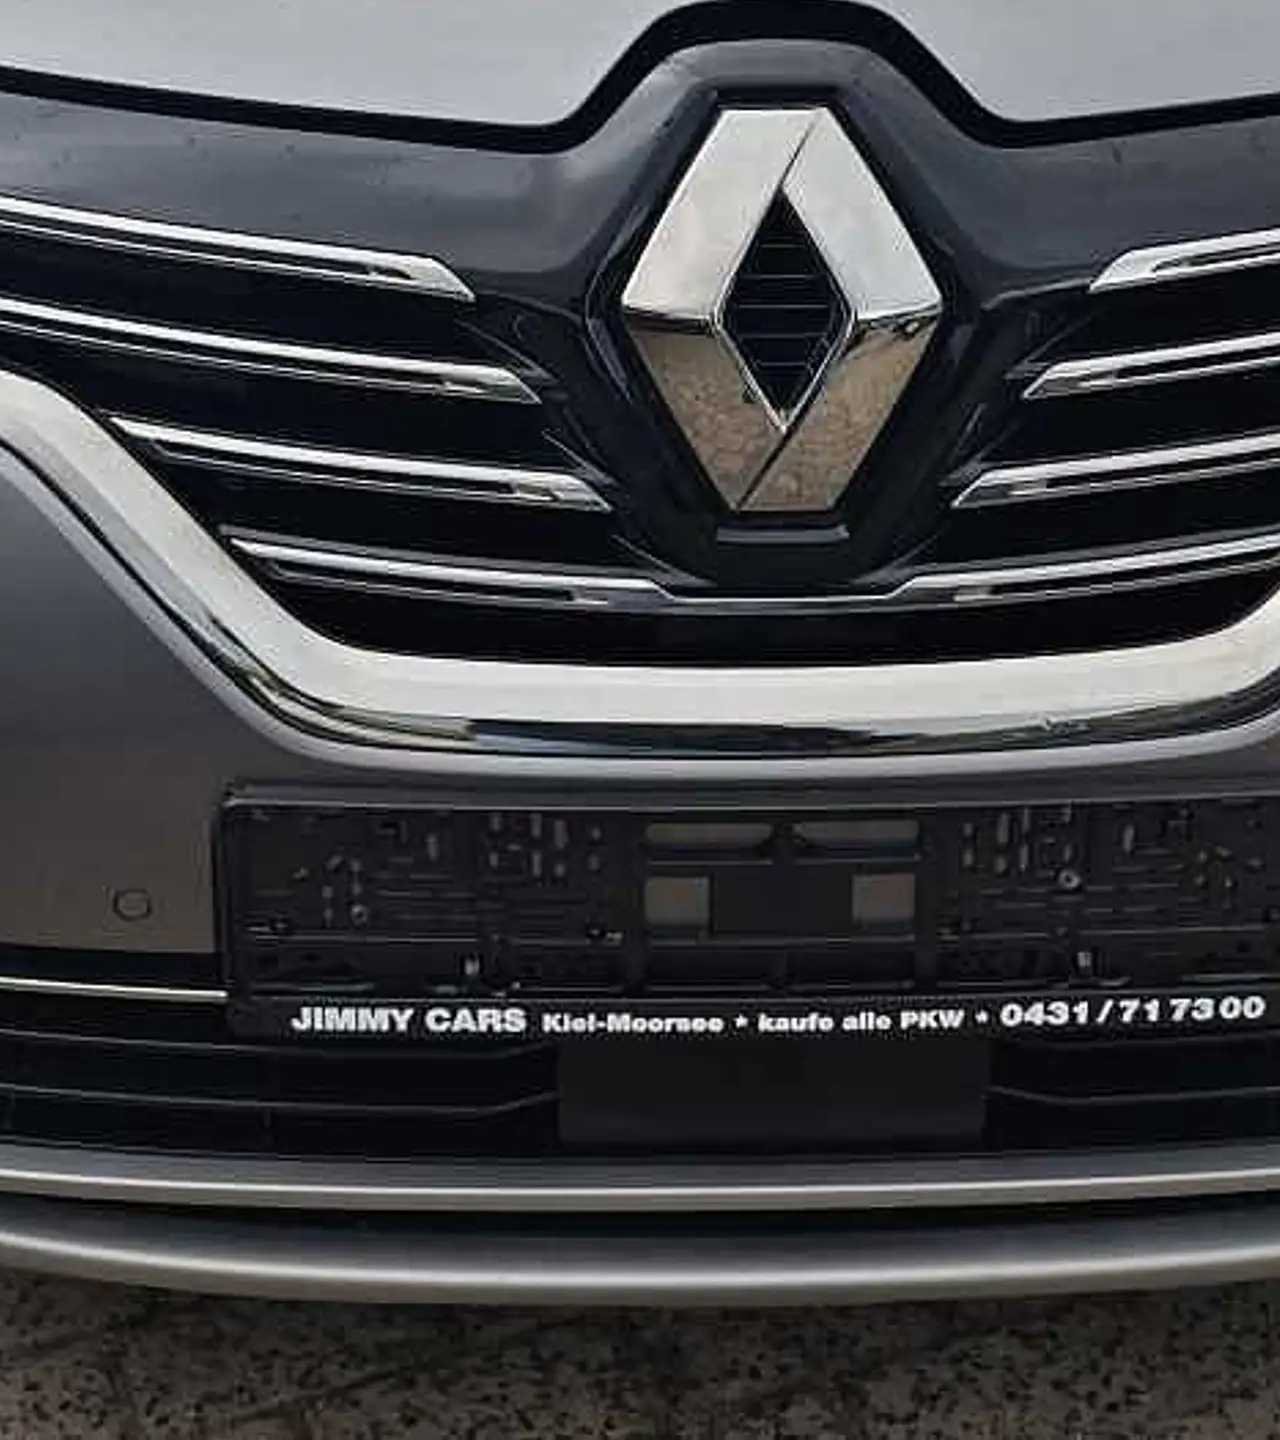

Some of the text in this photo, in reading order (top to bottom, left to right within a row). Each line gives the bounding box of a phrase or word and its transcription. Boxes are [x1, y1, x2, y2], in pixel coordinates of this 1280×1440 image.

[290, 1006, 415, 1033] JIMMY
[424, 1006, 527, 1034] CARS
[841, 1011, 892, 1032] alle
[899, 1008, 966, 1031] PKW
